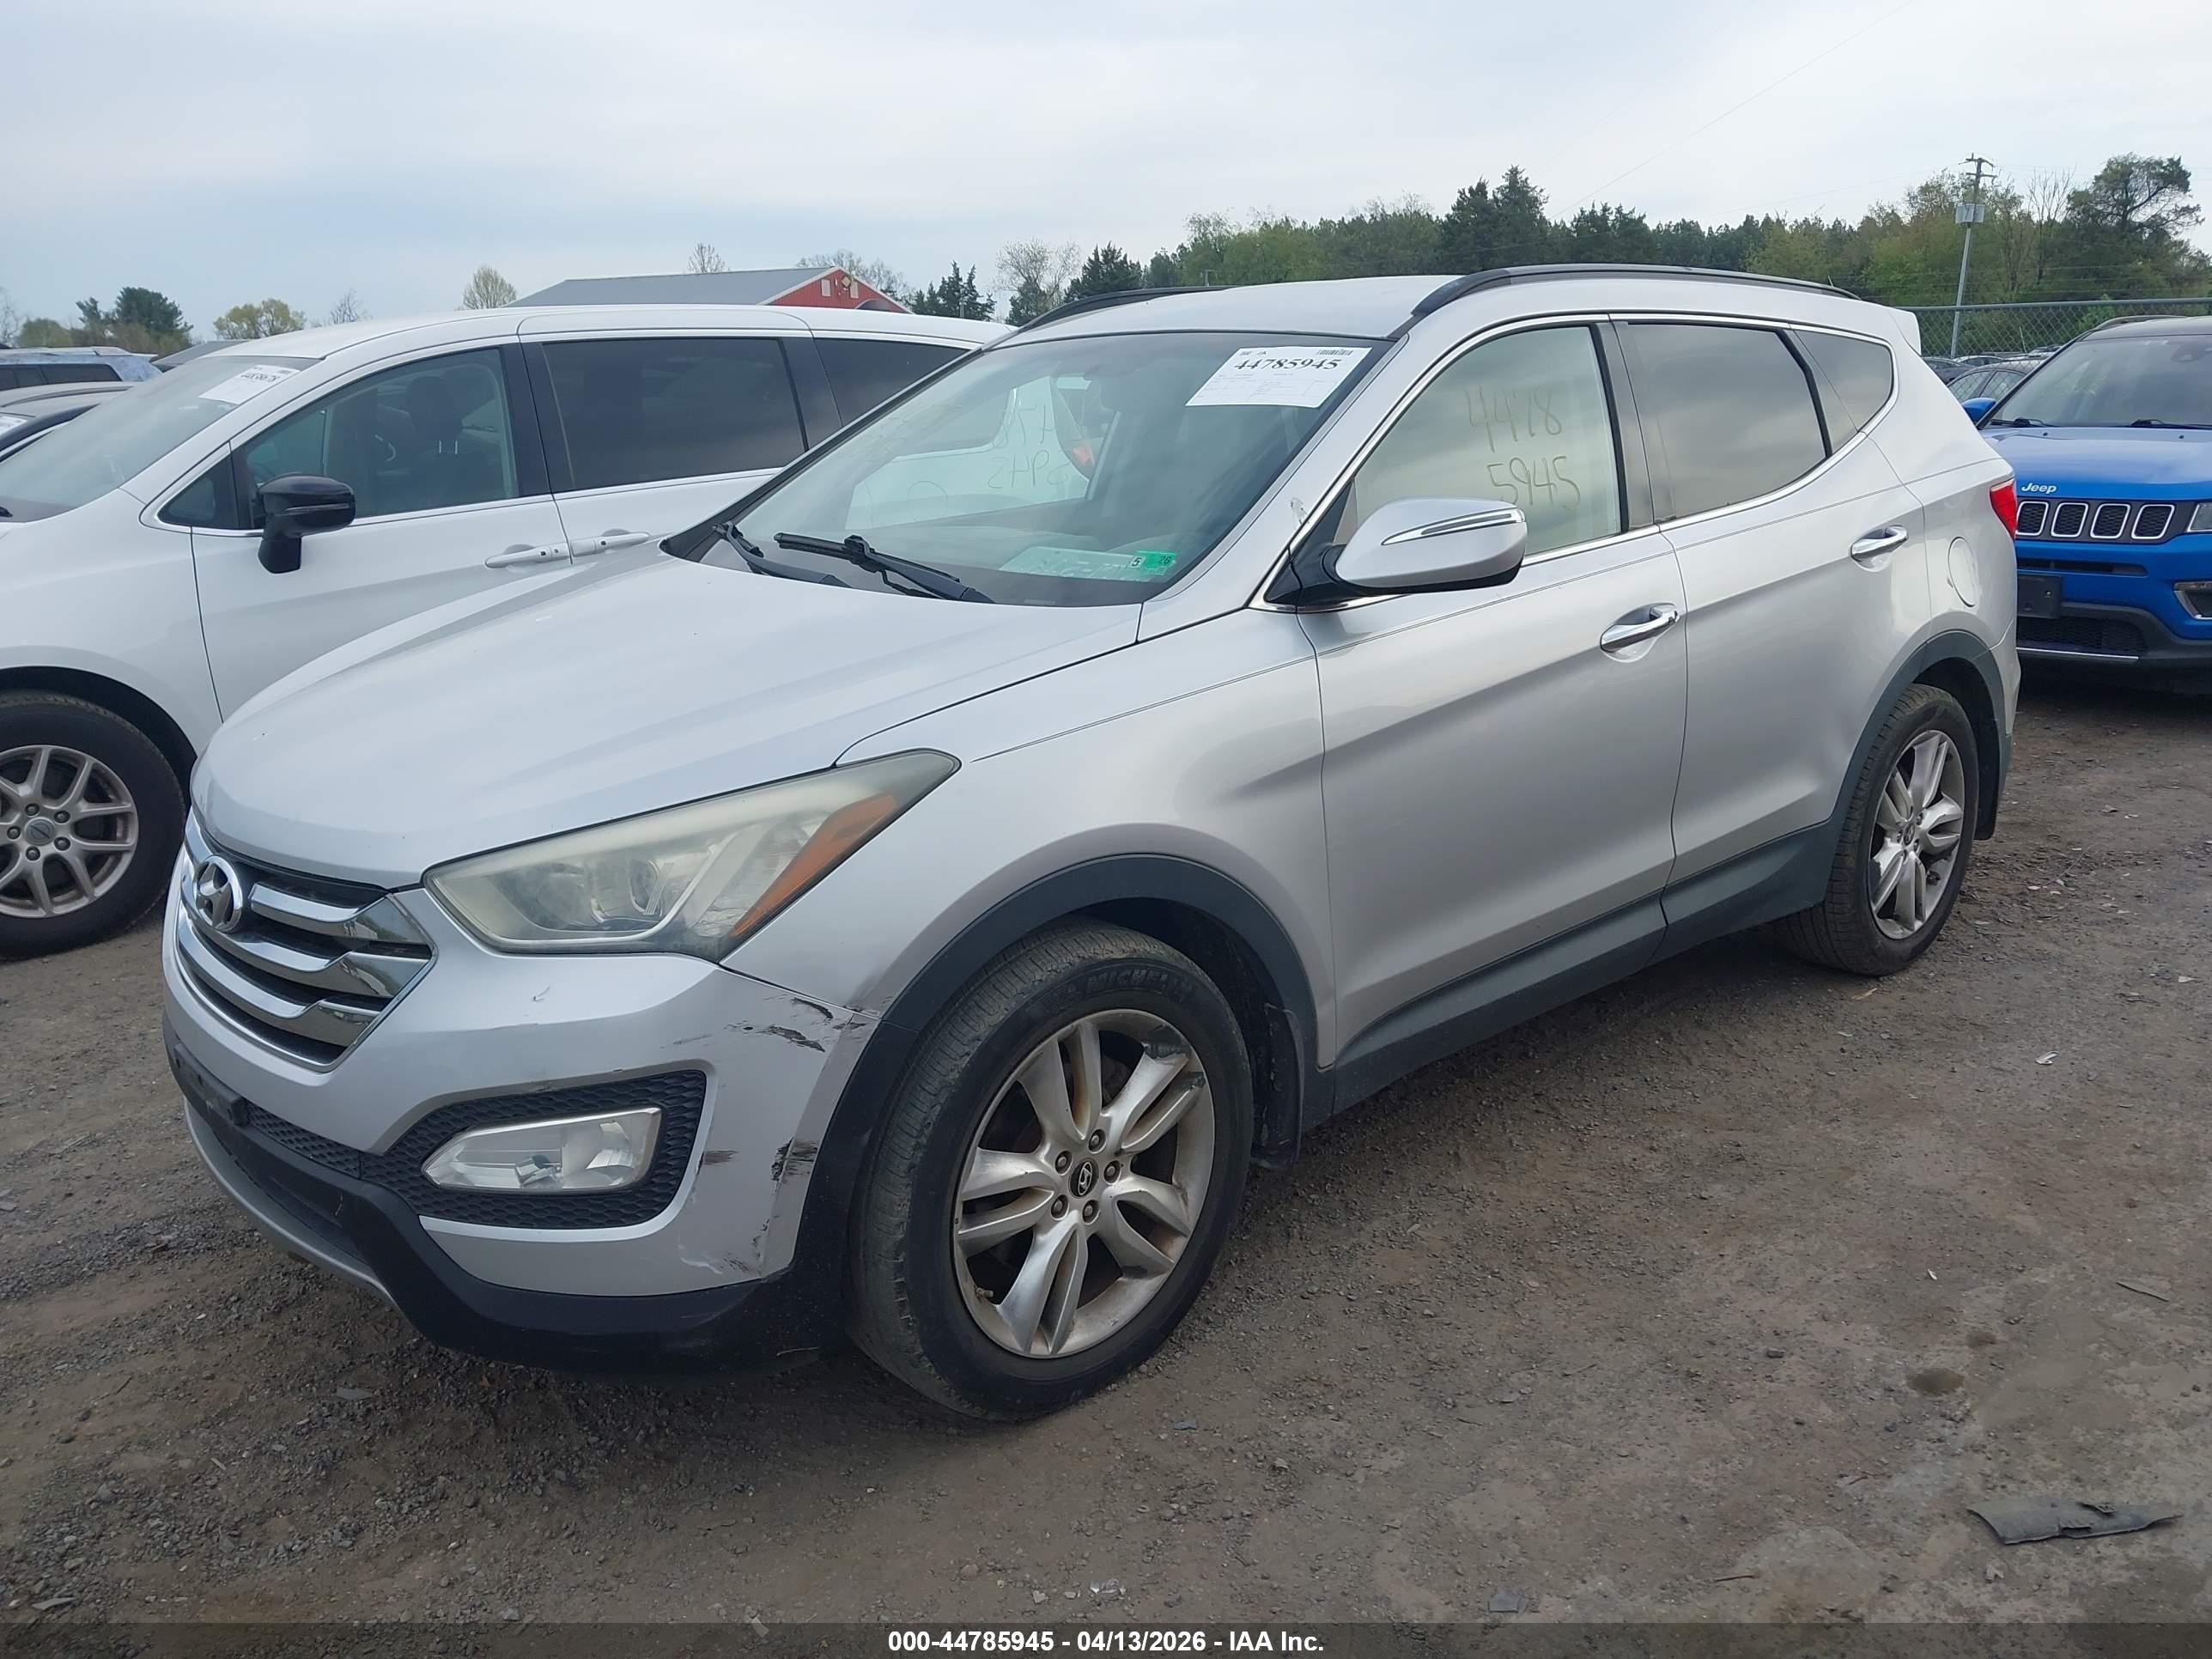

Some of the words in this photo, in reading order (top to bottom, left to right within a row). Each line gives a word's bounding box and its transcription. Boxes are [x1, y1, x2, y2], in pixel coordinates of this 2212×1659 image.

[1234, 358, 1342, 370] 44785945
[1462, 386, 1563, 453] 4478
[1486, 456, 1581, 510] 5945
[2021, 483, 2057, 494] Jeep
[1132, 556, 1143, 567] 5
